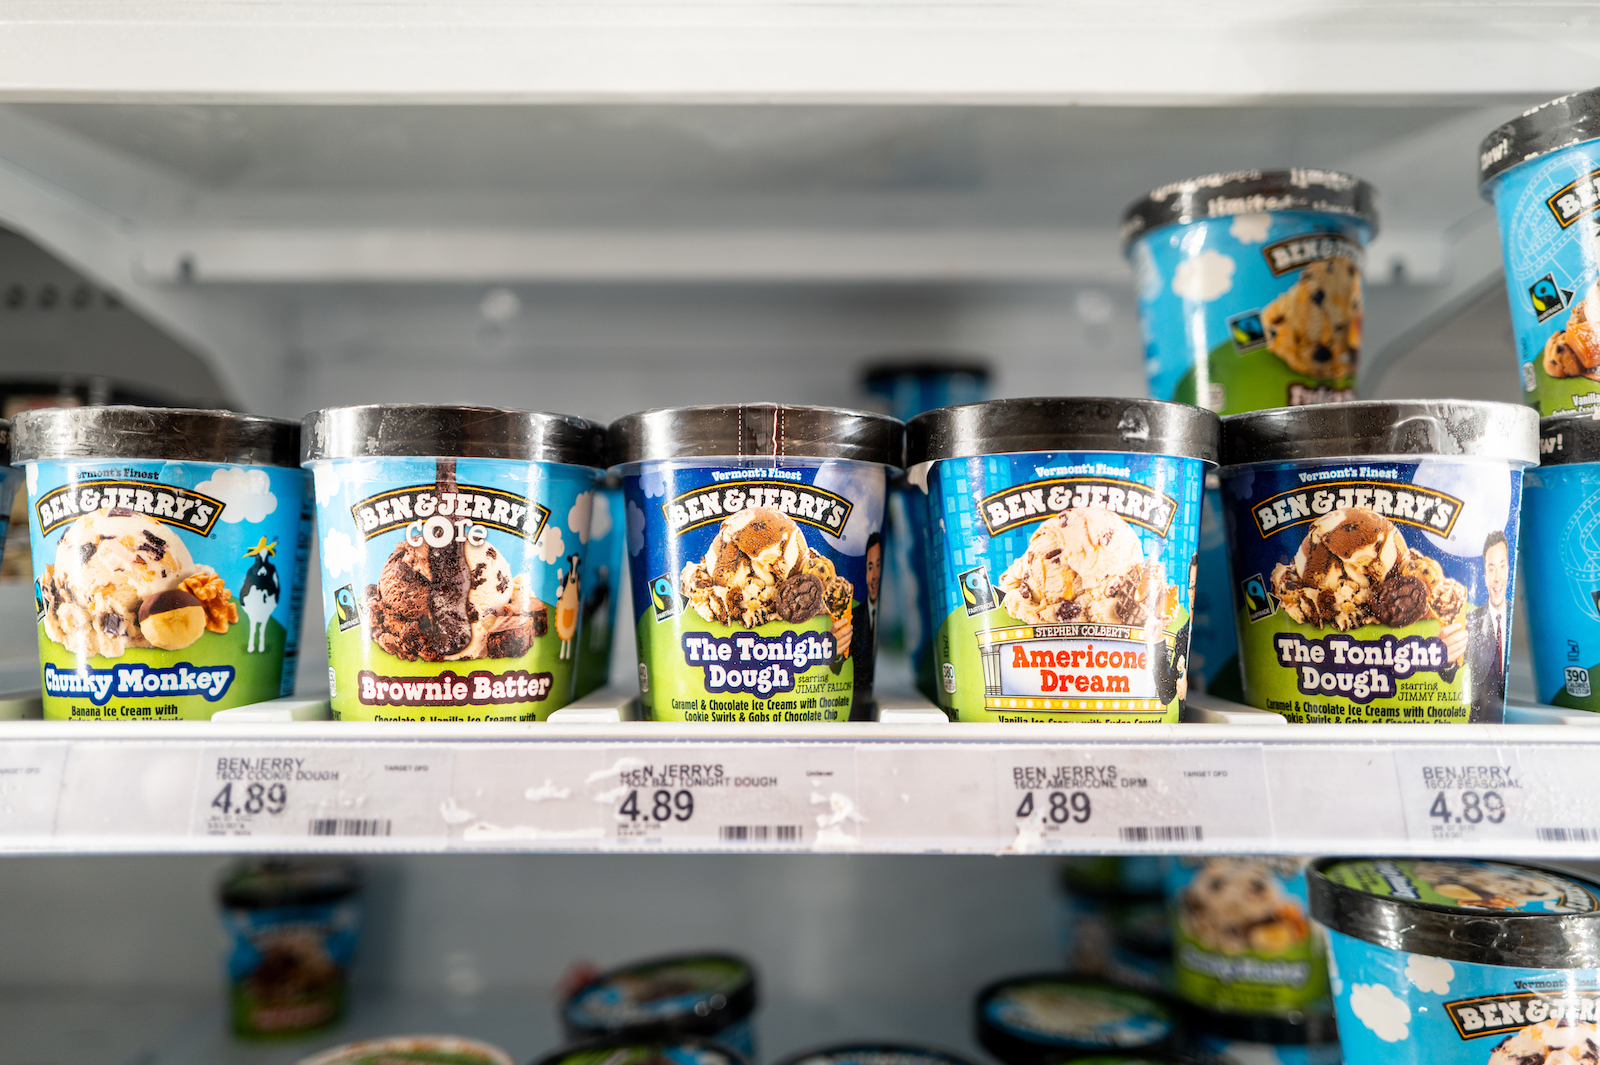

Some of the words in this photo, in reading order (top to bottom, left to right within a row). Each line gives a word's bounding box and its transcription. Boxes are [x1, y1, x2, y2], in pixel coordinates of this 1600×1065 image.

[1539, 433, 1563, 454] w!
[75, 468, 120, 479] ermont's
[123, 468, 160, 480] Finest
[711, 469, 768, 481] Vermont's
[769, 468, 802, 480] Finest
[1035, 464, 1095, 478] Vermont's
[1096, 464, 1131, 478] Finest
[1298, 467, 1358, 482] Vermont's
[1359, 467, 1398, 479] Finest
[967, 601, 995, 615] FAIRTRADE
[1035, 627, 1079, 638] STEPHEN
[1081, 626, 1131, 638] COLBERT'S
[686, 638, 732, 660] The
[737, 637, 832, 667] Tonight
[1012, 644, 1148, 669] Americone
[1278, 639, 1326, 663] The
[1329, 639, 1442, 673] Tonight
[710, 664, 789, 692] Dough
[798, 674, 829, 684] starring
[1040, 670, 1130, 693] Dream
[1301, 667, 1390, 698] Dough
[1565, 669, 1587, 683] 390
[45, 668, 113, 701] Chunky
[118, 668, 230, 697] Monkey
[361, 676, 469, 702] Brownie
[472, 675, 550, 699] Batter
[795, 684, 826, 694] JIMMY
[827, 682, 852, 692] FALLON
[1400, 682, 1439, 692] starring
[672, 698, 698, 710] Caramel
[700, 699, 707, 710] &
[709, 699, 749, 711] Chocolate
[752, 699, 764, 711] Ice
[767, 699, 797, 711] Creams
[799, 698, 817, 709] with
[819, 696, 850, 708] Chocolate
[1397, 692, 1433, 702] JIMMY
[1437, 692, 1464, 701] FALLO
[71, 706, 101, 717] Banana
[104, 706, 117, 717] Ice
[120, 705, 152, 716] Cream
[155, 704, 178, 715] with
[1266, 699, 1292, 711] Caramel
[1294, 701, 1301, 711] &
[1303, 702, 1345, 715] Chocolate
[1348, 704, 1362, 716] Ice
[1365, 705, 1400, 717] Creams
[1403, 705, 1424, 718] with
[1427, 706, 1467, 718] Chocolate
[685, 711, 709, 722] Cookie
[712, 711, 736, 722] Swirls
[739, 711, 746, 722] &
[748, 711, 770, 722] Gobs
[773, 711, 782, 722] of
[784, 711, 822, 722] Chocolate
[824, 710, 838, 722] Chip
[247, 771, 292, 780] COOKIE
[296, 771, 339, 780] DOUGH
[659, 764, 724, 778] JERRYS
[1013, 767, 1047, 780] BEN
[1052, 765, 1118, 779] JERRYS
[1182, 770, 1212, 778] TARGET
[652, 778, 675, 787] B&J
[678, 777, 731, 787] TONIGHT
[734, 777, 778, 787] DOUGH
[1046, 779, 1117, 789] AMERICONE
[1120, 778, 1148, 788] DRM
[1456, 779, 1523, 789] SEASONAL
[211, 782, 288, 814] 4.89
[618, 789, 694, 822] 4.89
[1015, 791, 1091, 824] 4.89
[1429, 790, 1506, 825] 4.89
